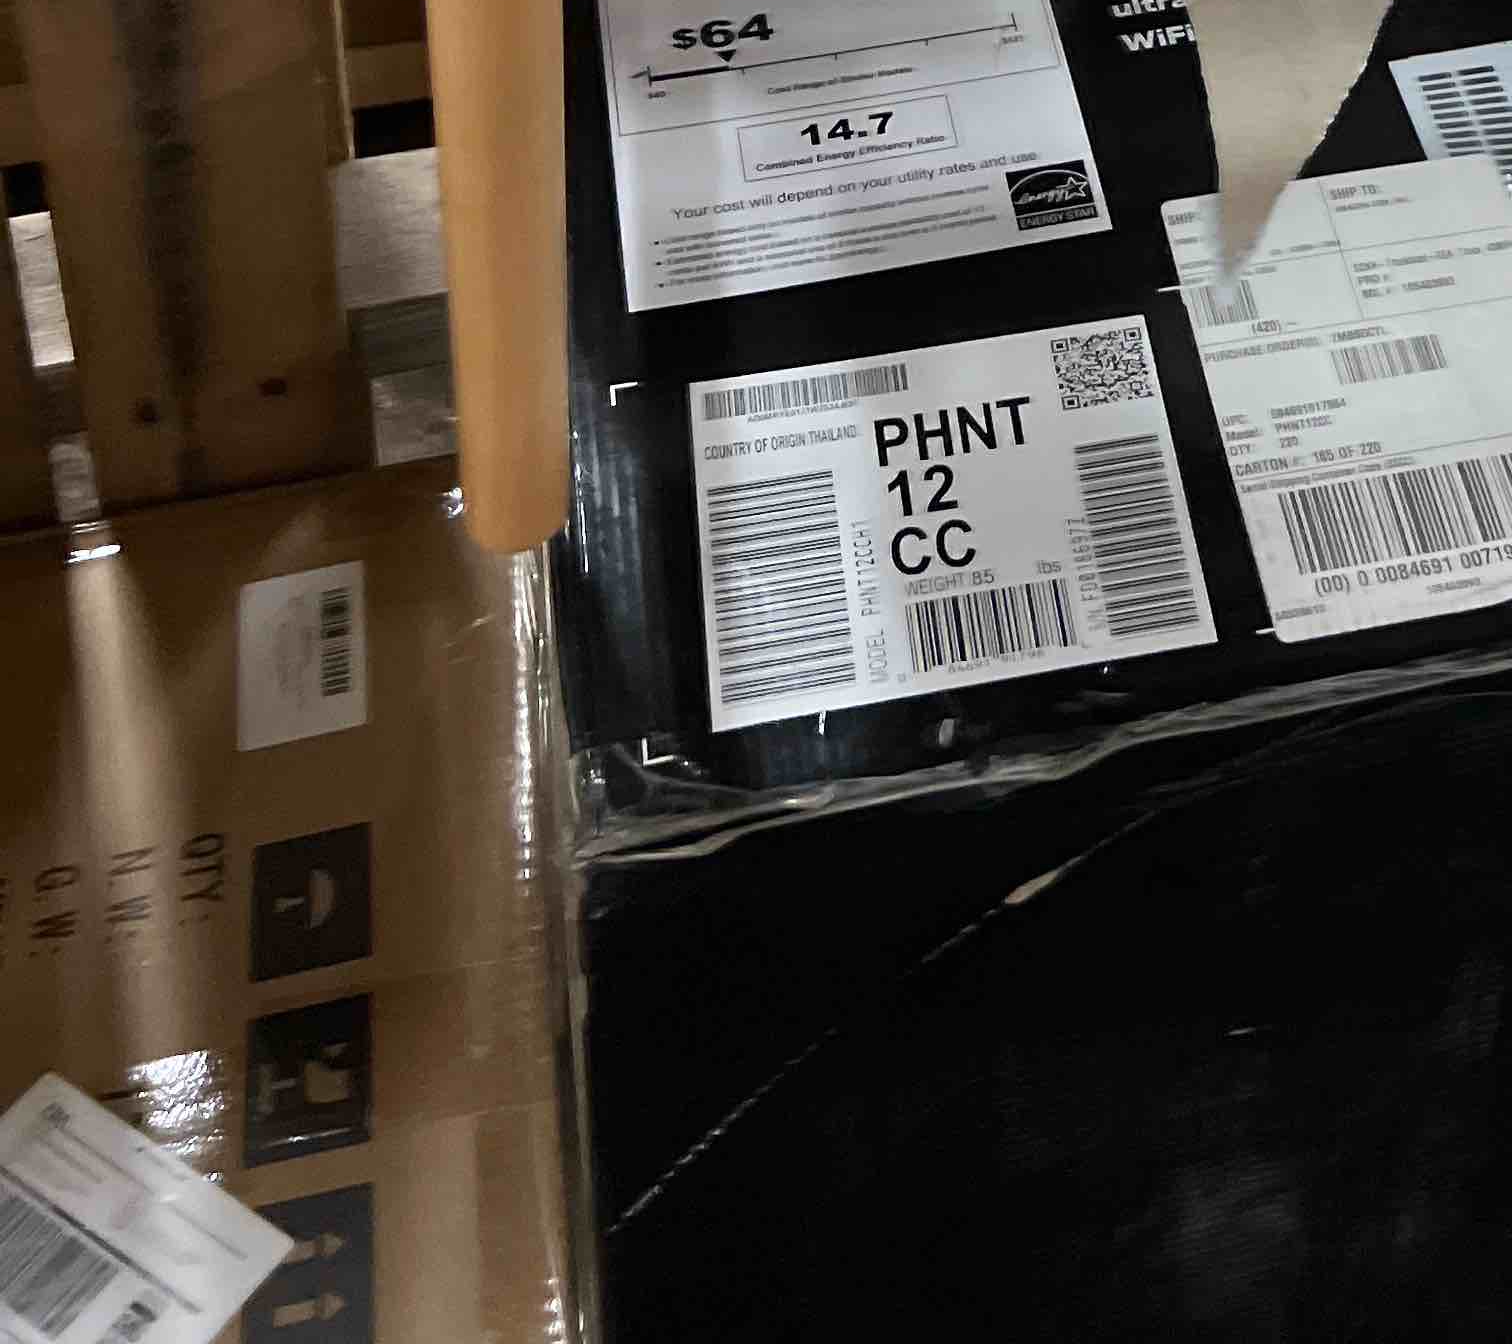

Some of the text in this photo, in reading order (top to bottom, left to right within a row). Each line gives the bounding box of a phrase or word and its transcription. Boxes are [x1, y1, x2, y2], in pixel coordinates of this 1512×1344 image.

[672, 13, 774, 50] $64
[1120, 24, 1196, 51] WiFi
[801, 111, 894, 145] 14.7
[756, 156, 813, 172] Combined
[817, 150, 856, 164] Energy
[859, 140, 914, 157] Efficiency
[671, 205, 710, 221] Your
[713, 200, 745, 214] cost
[749, 193, 773, 208] will
[777, 184, 834, 205] depend
[837, 181, 857, 194] on
[861, 175, 895, 194] your
[897, 167, 936, 190] utility
[938, 161, 978, 178] rates
[979, 156, 1007, 171] and
[1329, 185, 1357, 201] SHIP
[1019, 210, 1064, 229] ENERGY
[704, 424, 858, 461] COUNTRY OF ORIGIN THAILAND
[873, 396, 1031, 468] PHNT
[1235, 457, 1289, 477] CARTON
[1338, 445, 1355, 459] OF
[1359, 440, 1382, 457] 220
[887, 464, 959, 517] 12
[890, 518, 977, 576] CC
[905, 572, 965, 598] WEIGHT
[1037, 560, 1063, 575] lbs
[1314, 575, 1352, 598] (00)
[1357, 570, 1370, 587] 0
[1375, 557, 1453, 584] 0084691
[866, 628, 889, 683] MODEL
